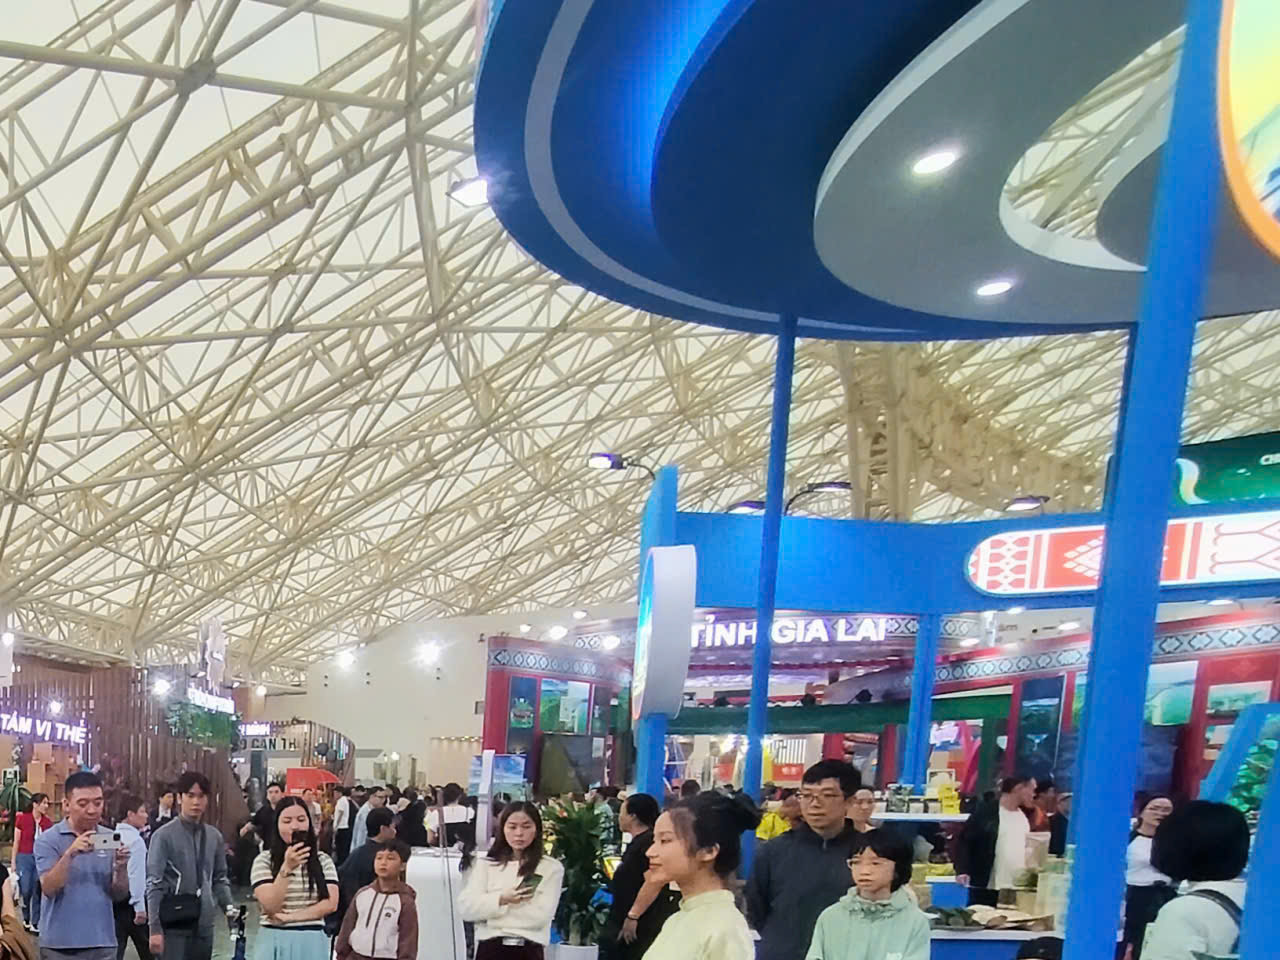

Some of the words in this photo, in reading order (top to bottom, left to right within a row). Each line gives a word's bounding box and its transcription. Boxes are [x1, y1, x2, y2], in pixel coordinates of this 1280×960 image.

[690, 614, 757, 648] TỈNH
[771, 617, 829, 644] GIA
[837, 617, 887, 642] LAI
